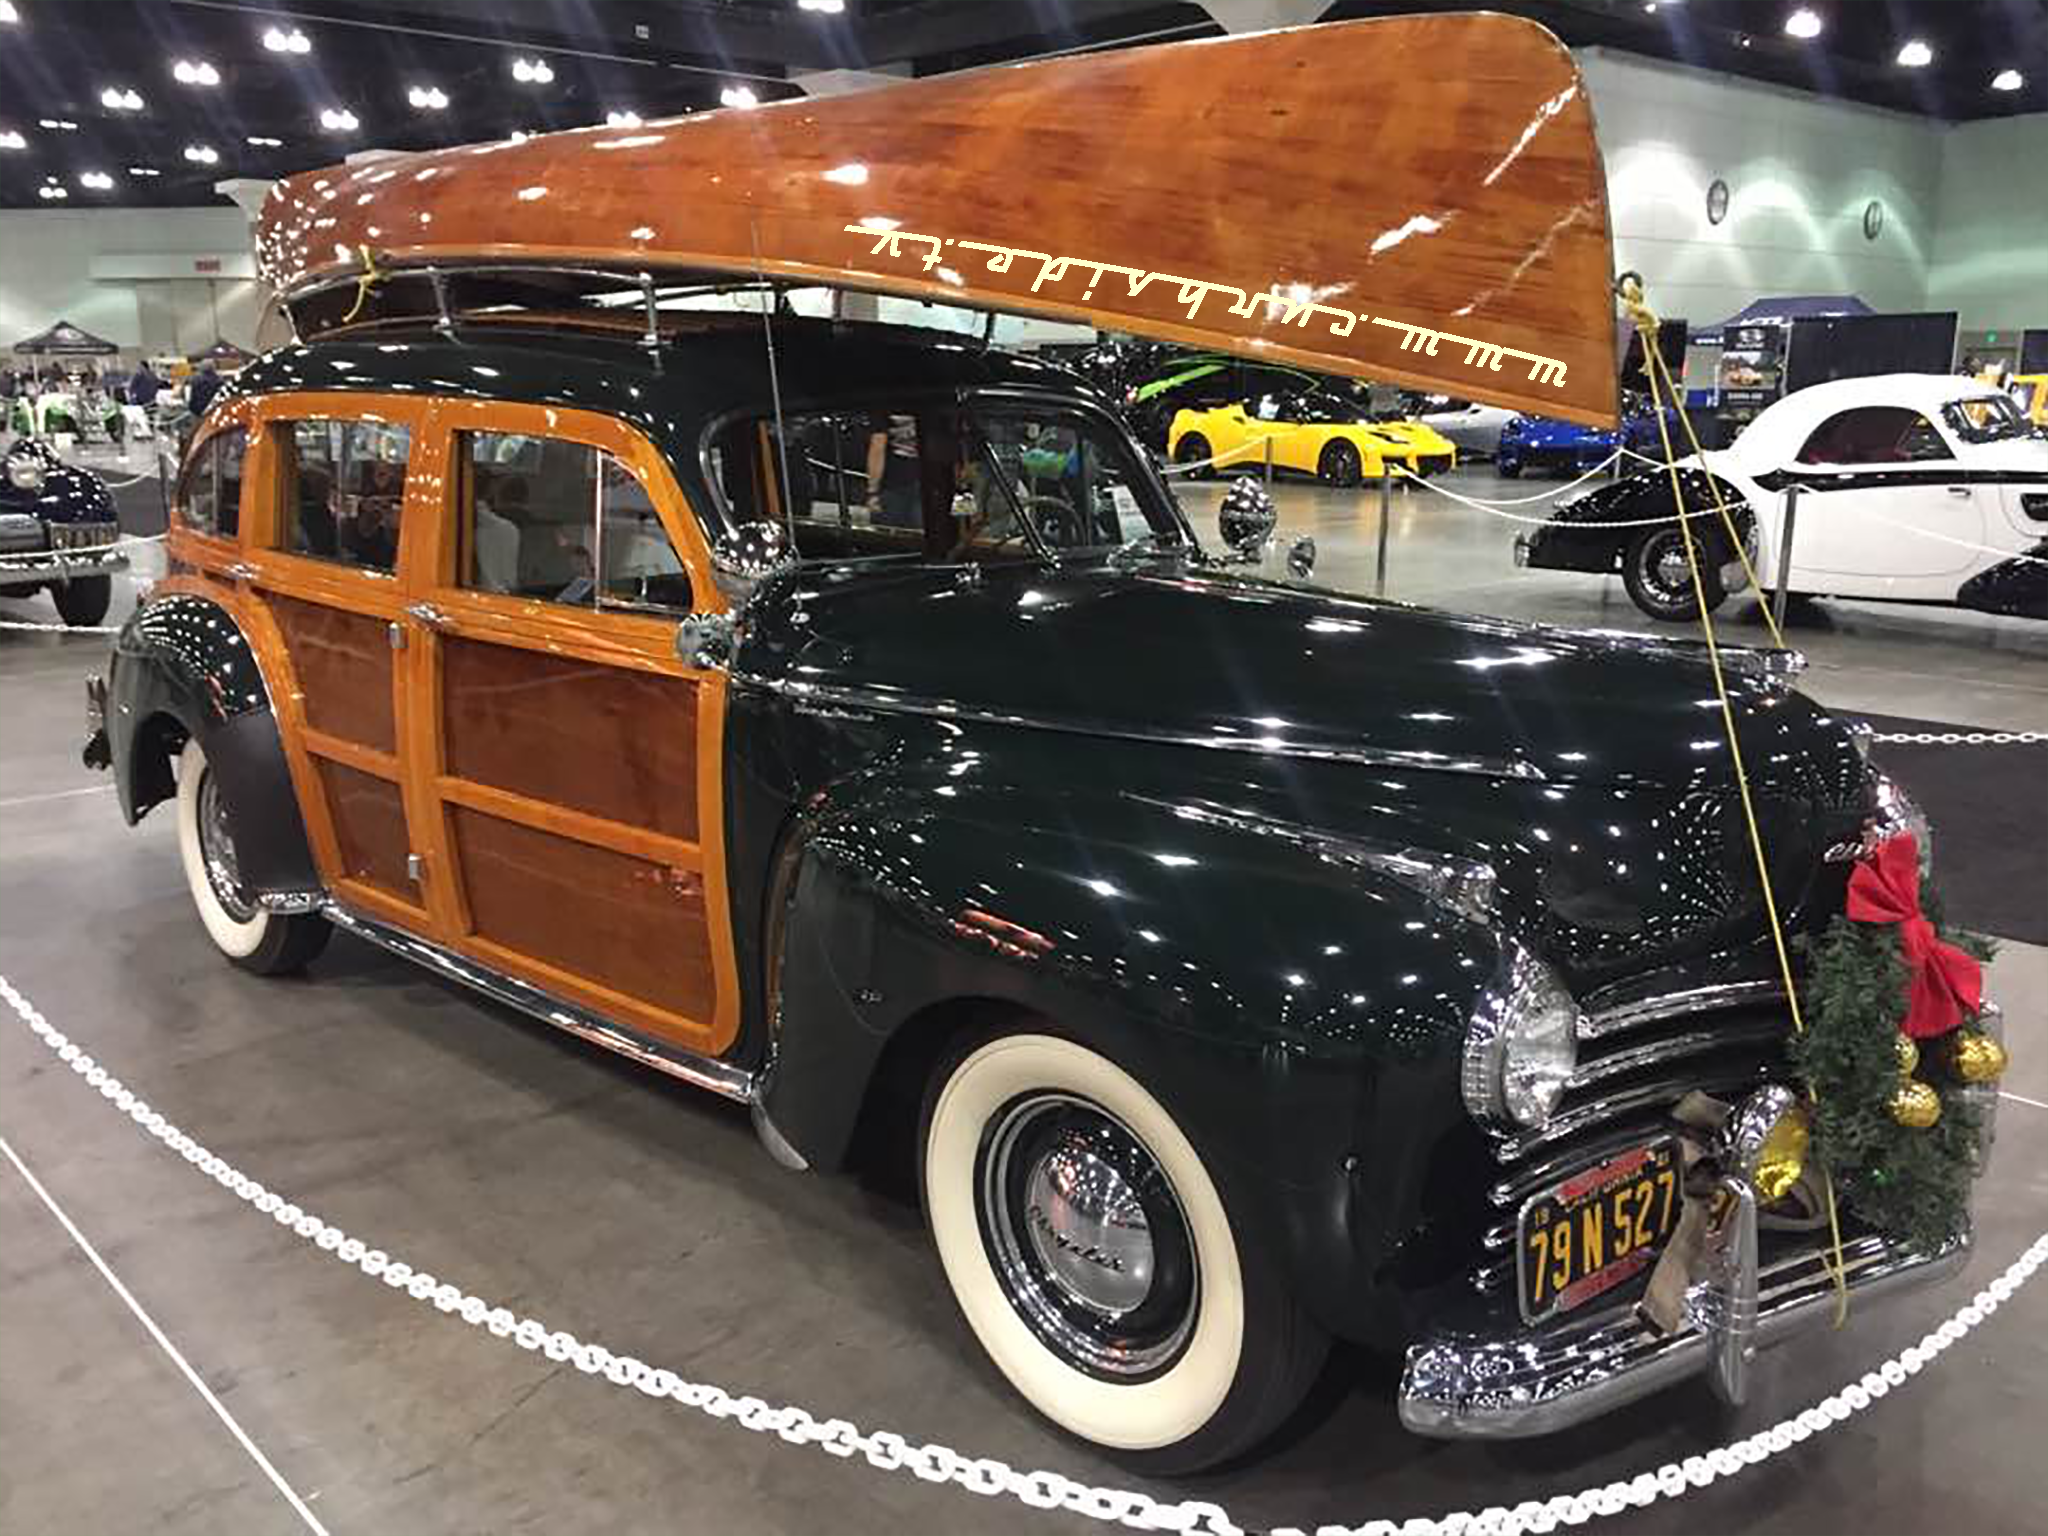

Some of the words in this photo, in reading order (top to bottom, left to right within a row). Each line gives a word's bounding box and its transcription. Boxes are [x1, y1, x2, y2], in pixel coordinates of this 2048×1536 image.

[1530, 1219, 1571, 1304] 79
[1582, 1201, 1603, 1274] N
[1614, 1169, 1674, 1257] 527
